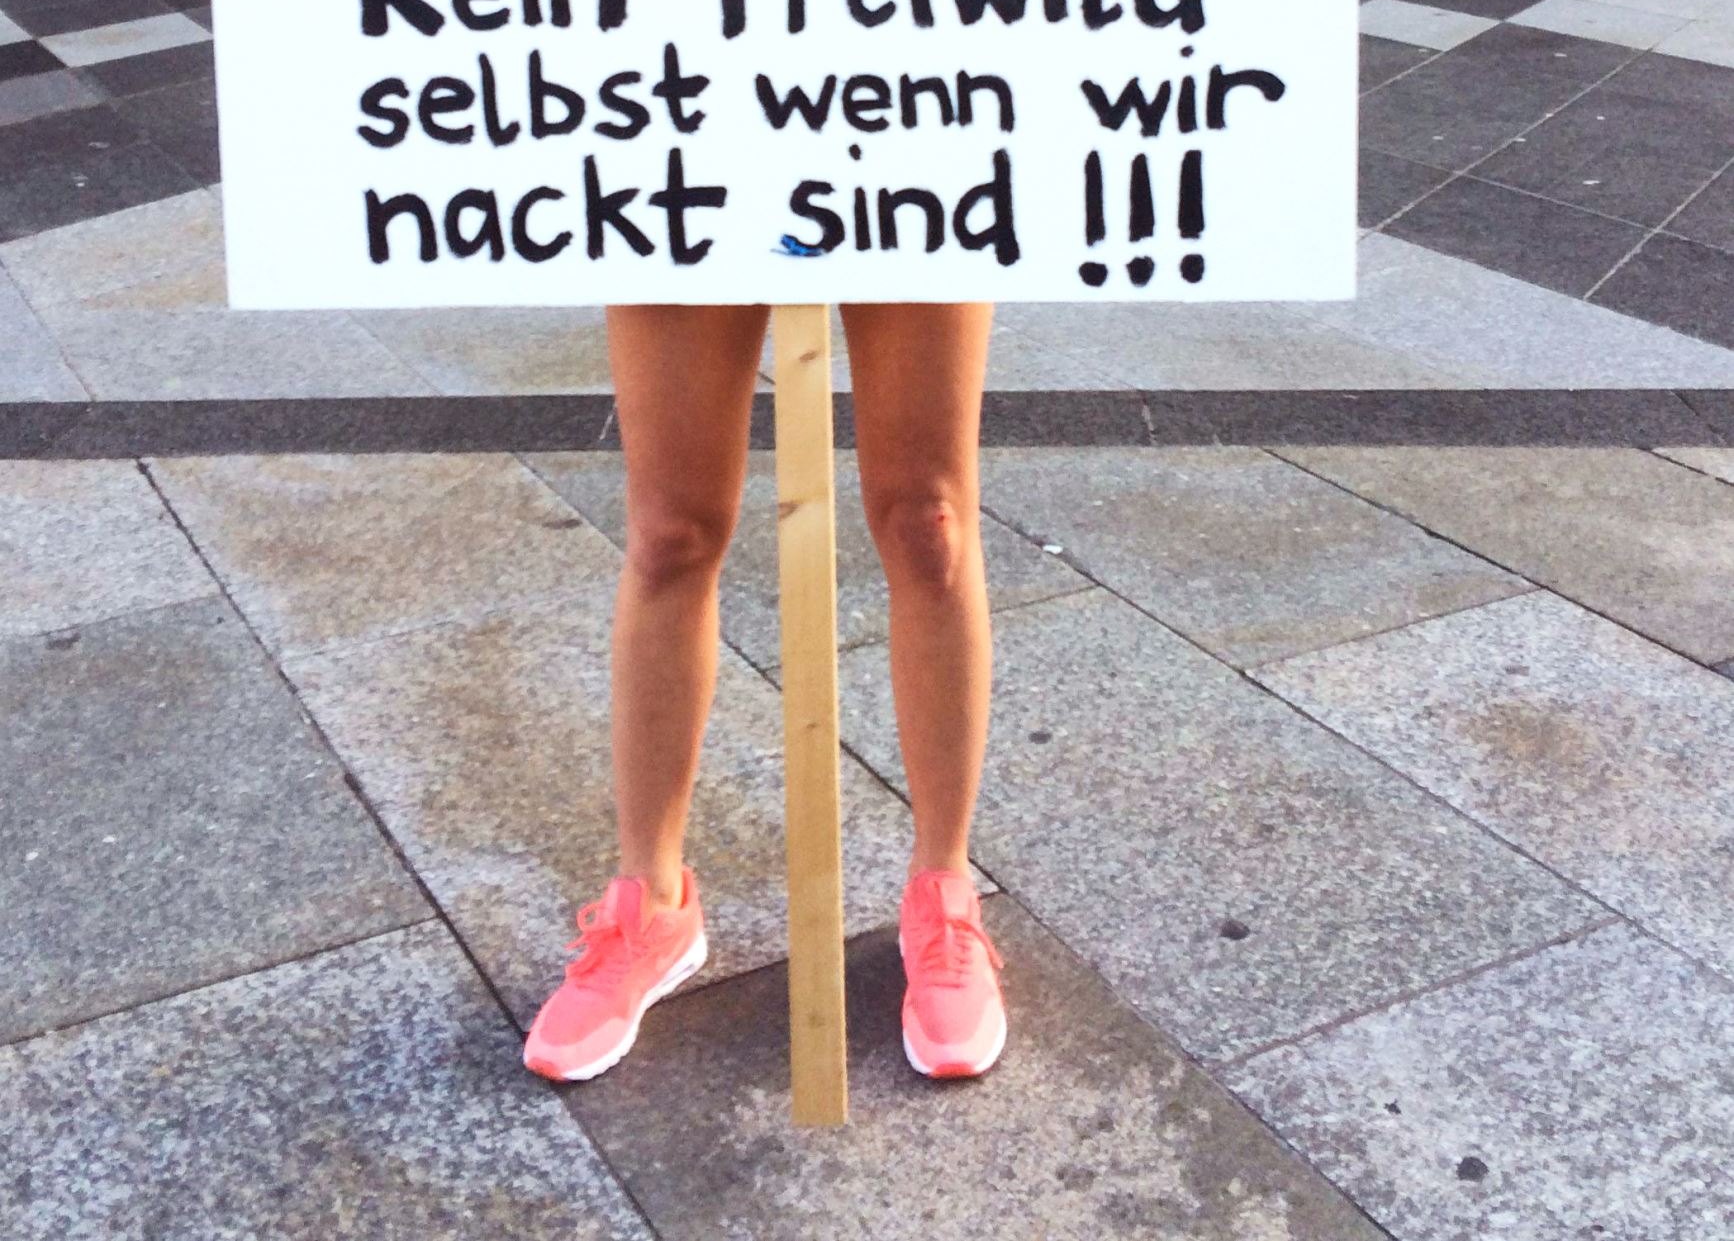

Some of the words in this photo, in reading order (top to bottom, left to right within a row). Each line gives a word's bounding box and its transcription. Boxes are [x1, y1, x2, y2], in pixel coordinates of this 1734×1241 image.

[357, 42, 711, 150] selbst
[754, 69, 1016, 134] wenn
[1080, 44, 1288, 139] wir
[364, 146, 729, 267] nackt
[776, 144, 1021, 268] sind
[1077, 148, 1206, 288] !!!
